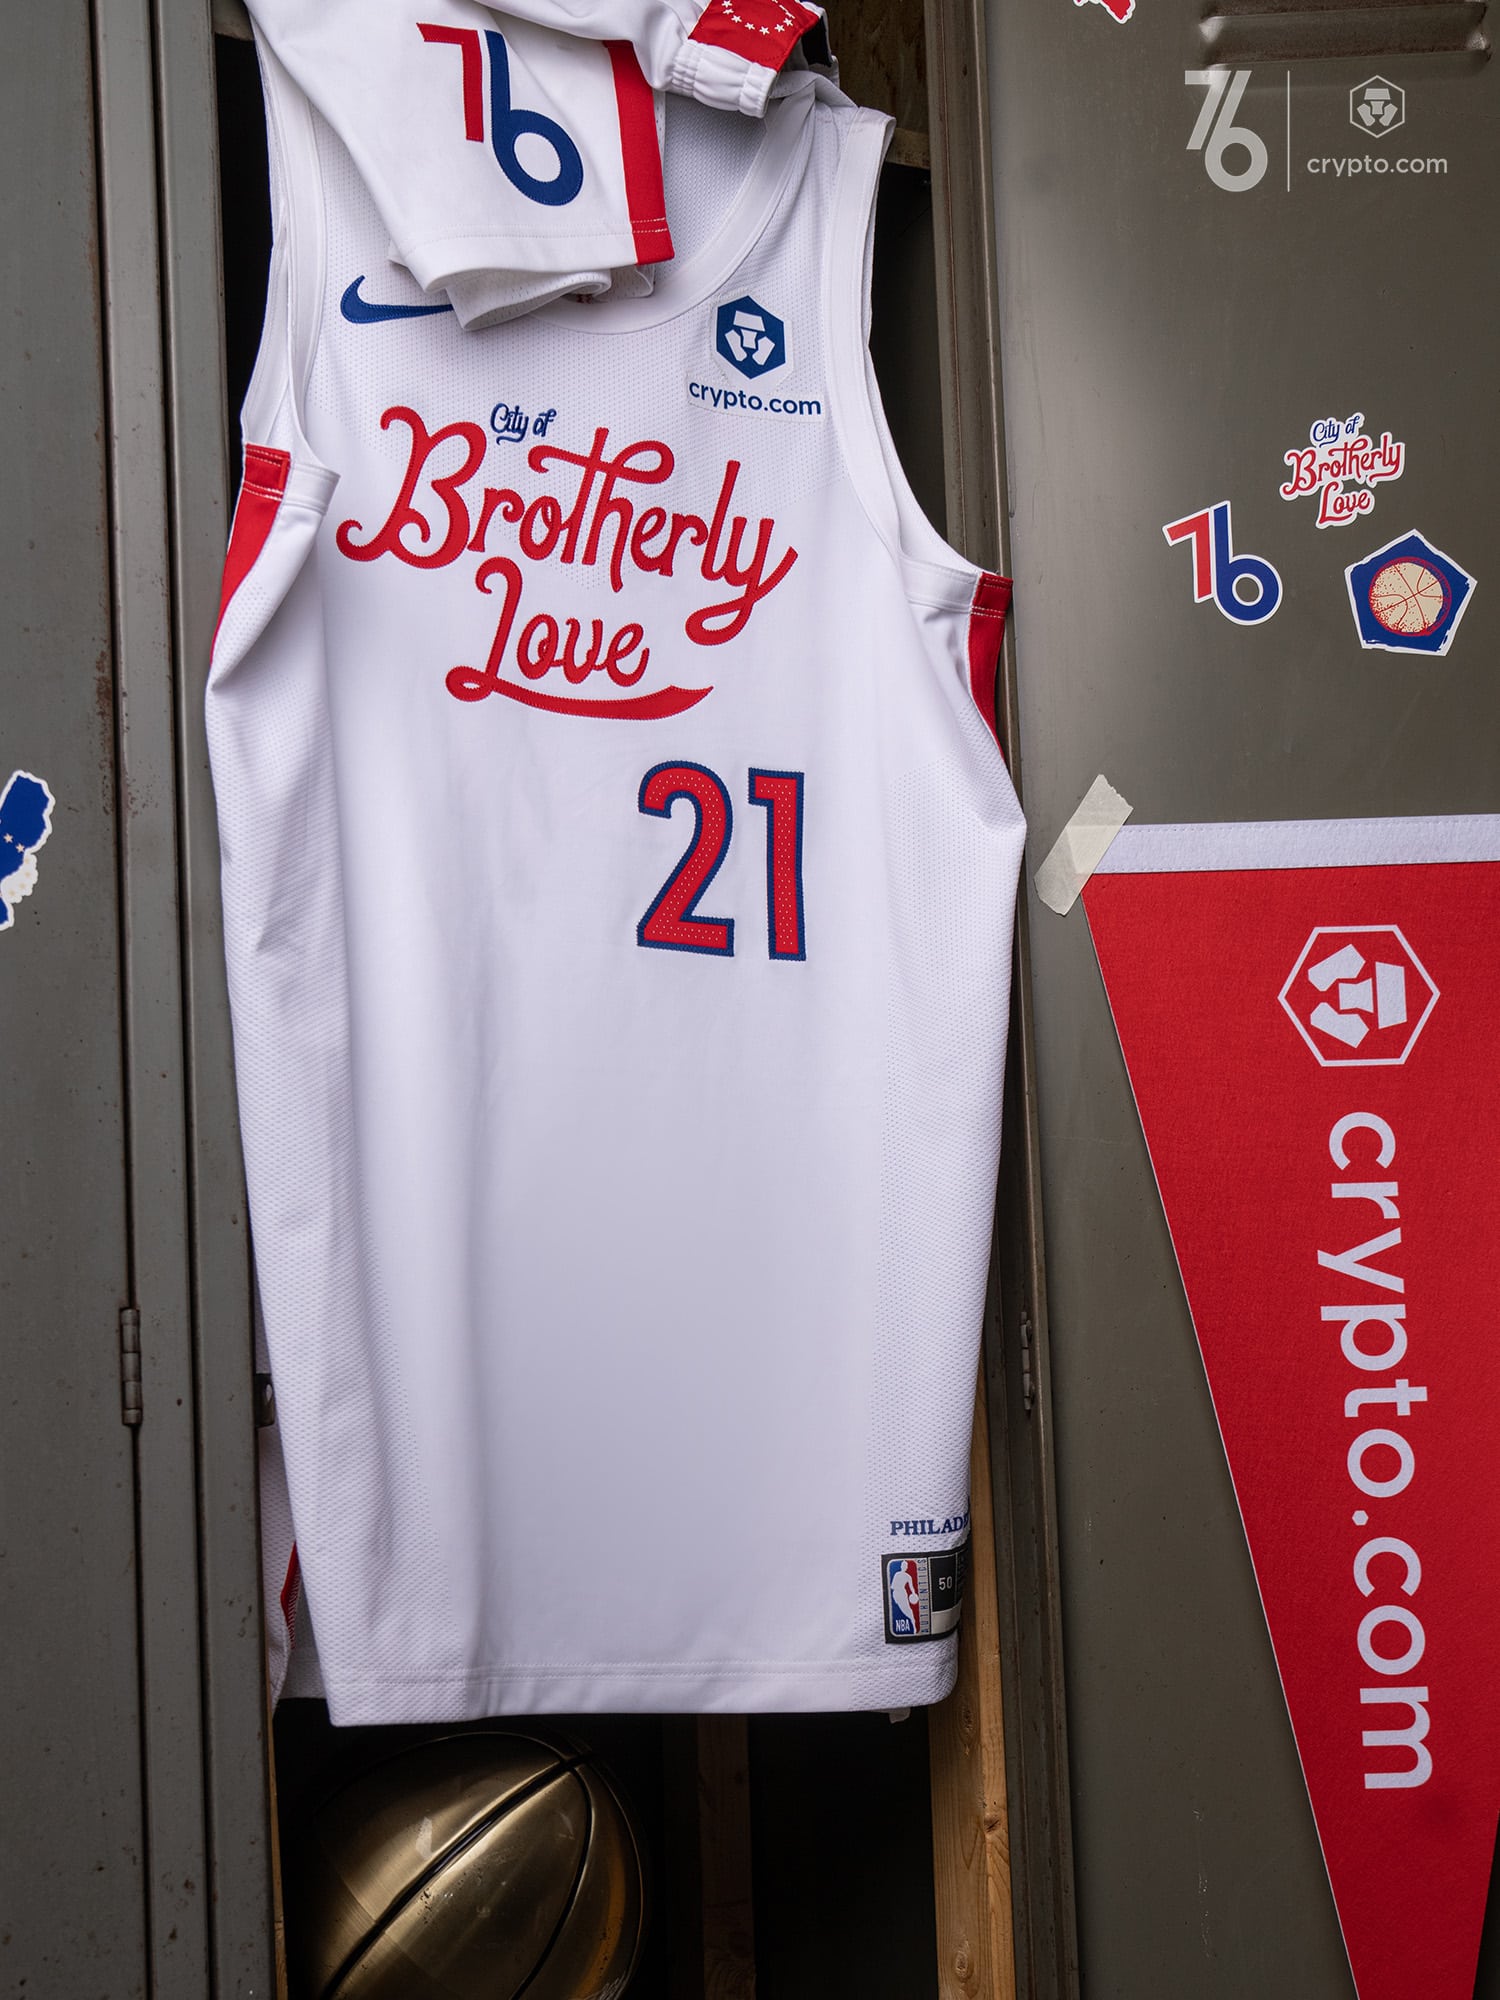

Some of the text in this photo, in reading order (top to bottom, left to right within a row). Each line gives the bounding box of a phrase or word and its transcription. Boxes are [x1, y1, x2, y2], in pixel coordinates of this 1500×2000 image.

[417, 24, 584, 207] 76
[490, 403, 557, 444] City of
[689, 382, 822, 415] crypto.com
[1312, 415, 1360, 448] City of
[1282, 434, 1401, 496] Brotherly
[336, 405, 799, 646] Brotherly
[1318, 481, 1371, 525] Love
[1166, 503, 1281, 622] 76
[445, 556, 714, 720] Love
[637, 759, 807, 962] 21
[1317, 1111, 1433, 1789] crypto.com
[917, 1558, 930, 1633] AUTHENTICS
[938, 1576, 953, 1591] 50
[895, 1619, 911, 1632] NBA
